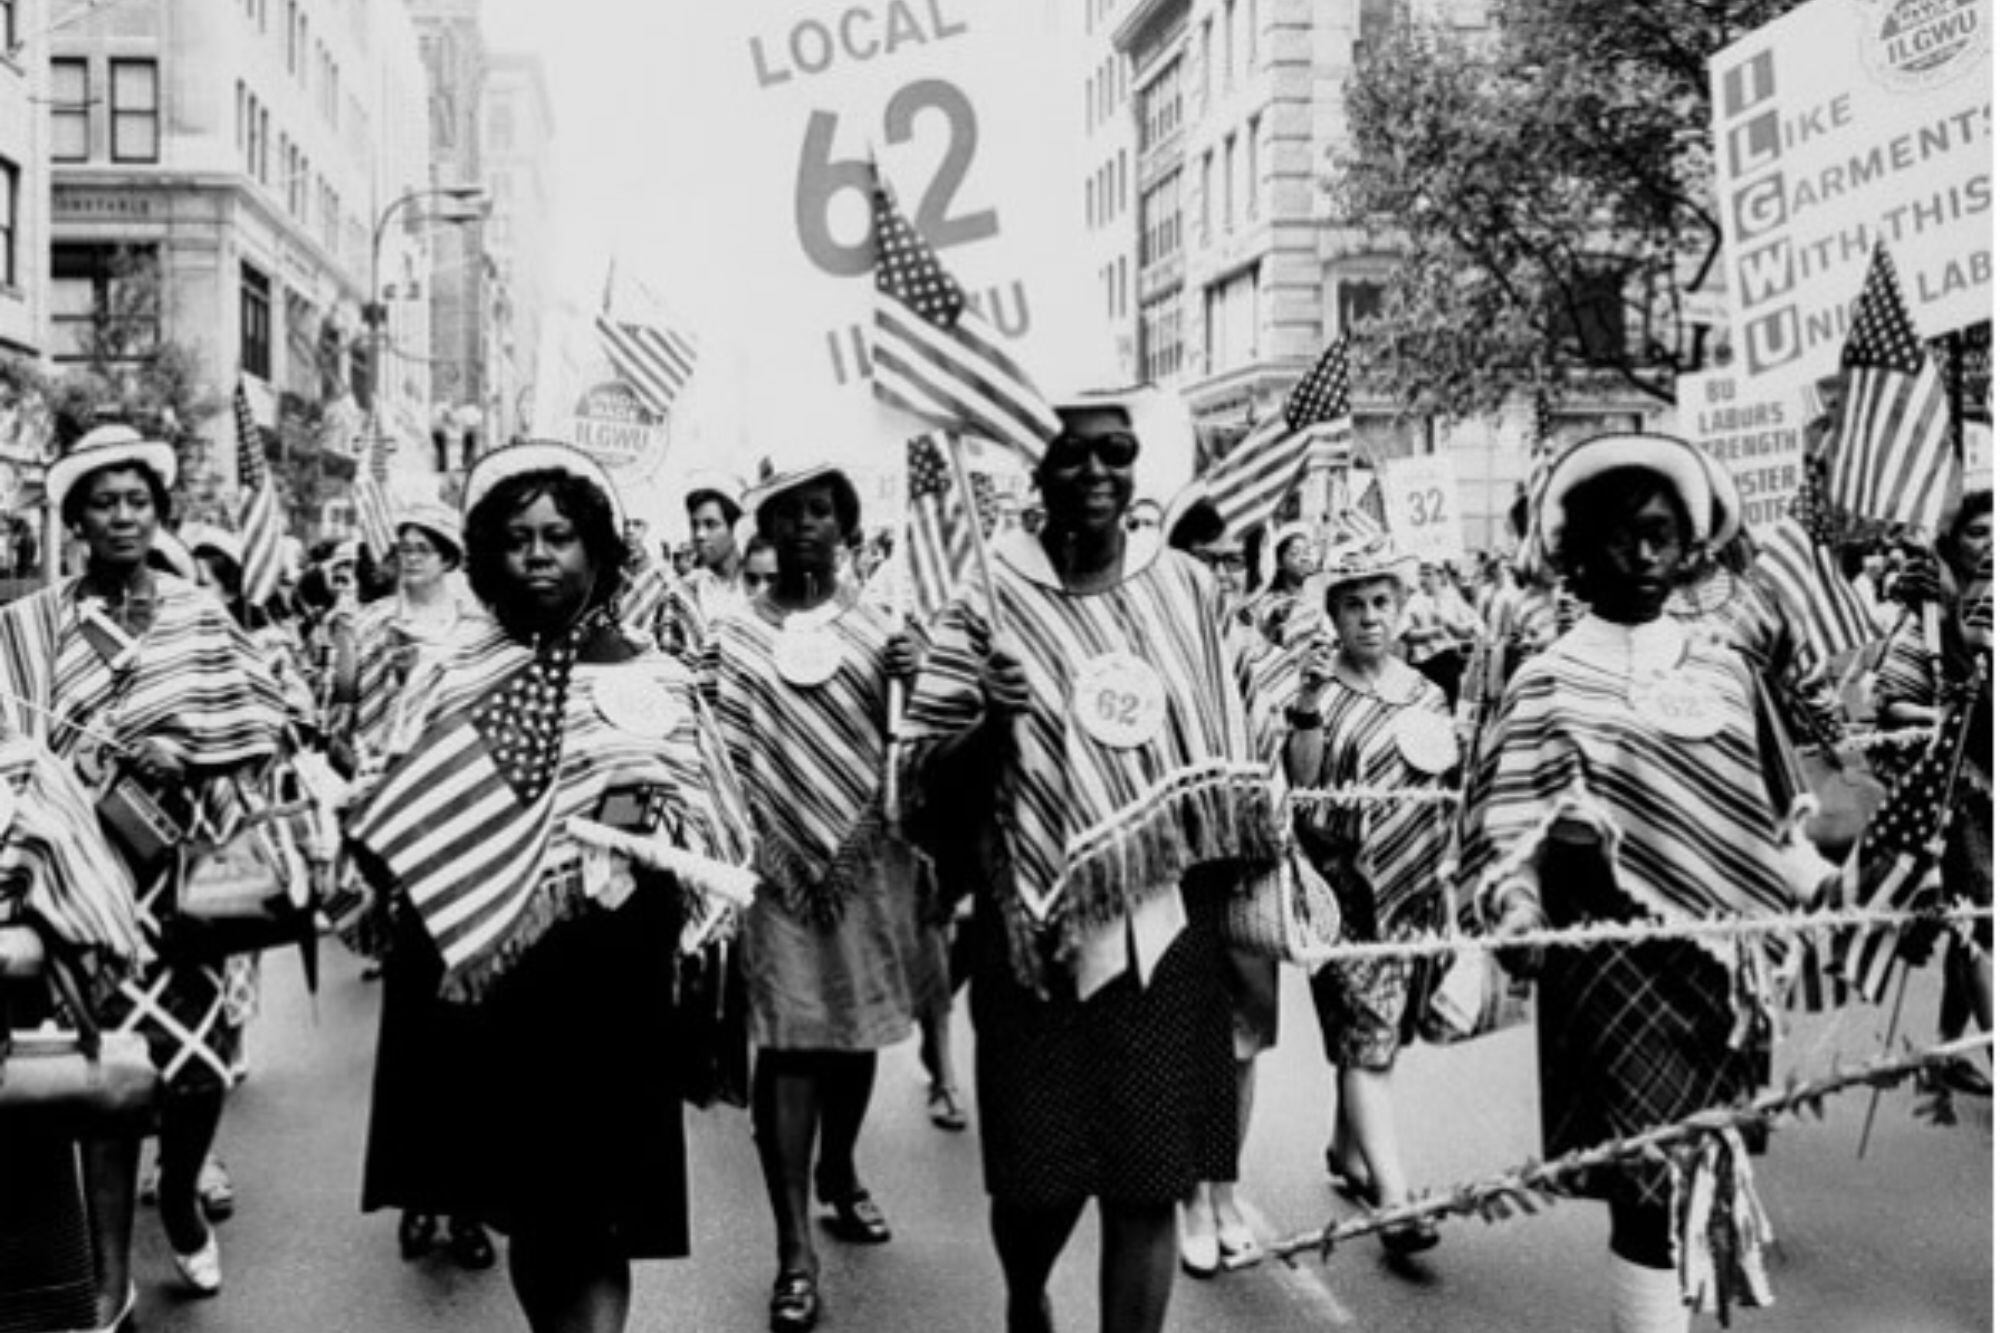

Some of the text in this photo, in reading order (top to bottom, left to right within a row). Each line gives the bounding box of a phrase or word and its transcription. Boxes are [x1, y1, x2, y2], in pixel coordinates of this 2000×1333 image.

[750, 0, 967, 87] LOCAL
[1887, 9, 1977, 64] ILGWU
[794, 78, 1000, 278] 62
[1882, 175, 1992, 242] THIS
[826, 280, 1030, 386] ILU
[1745, 251, 1992, 375] UNI LAB
[575, 421, 649, 452] ILGWU
[1406, 487, 1448, 527] 32
[1097, 689, 1140, 727] 62
[1658, 691, 1707, 719] 62
